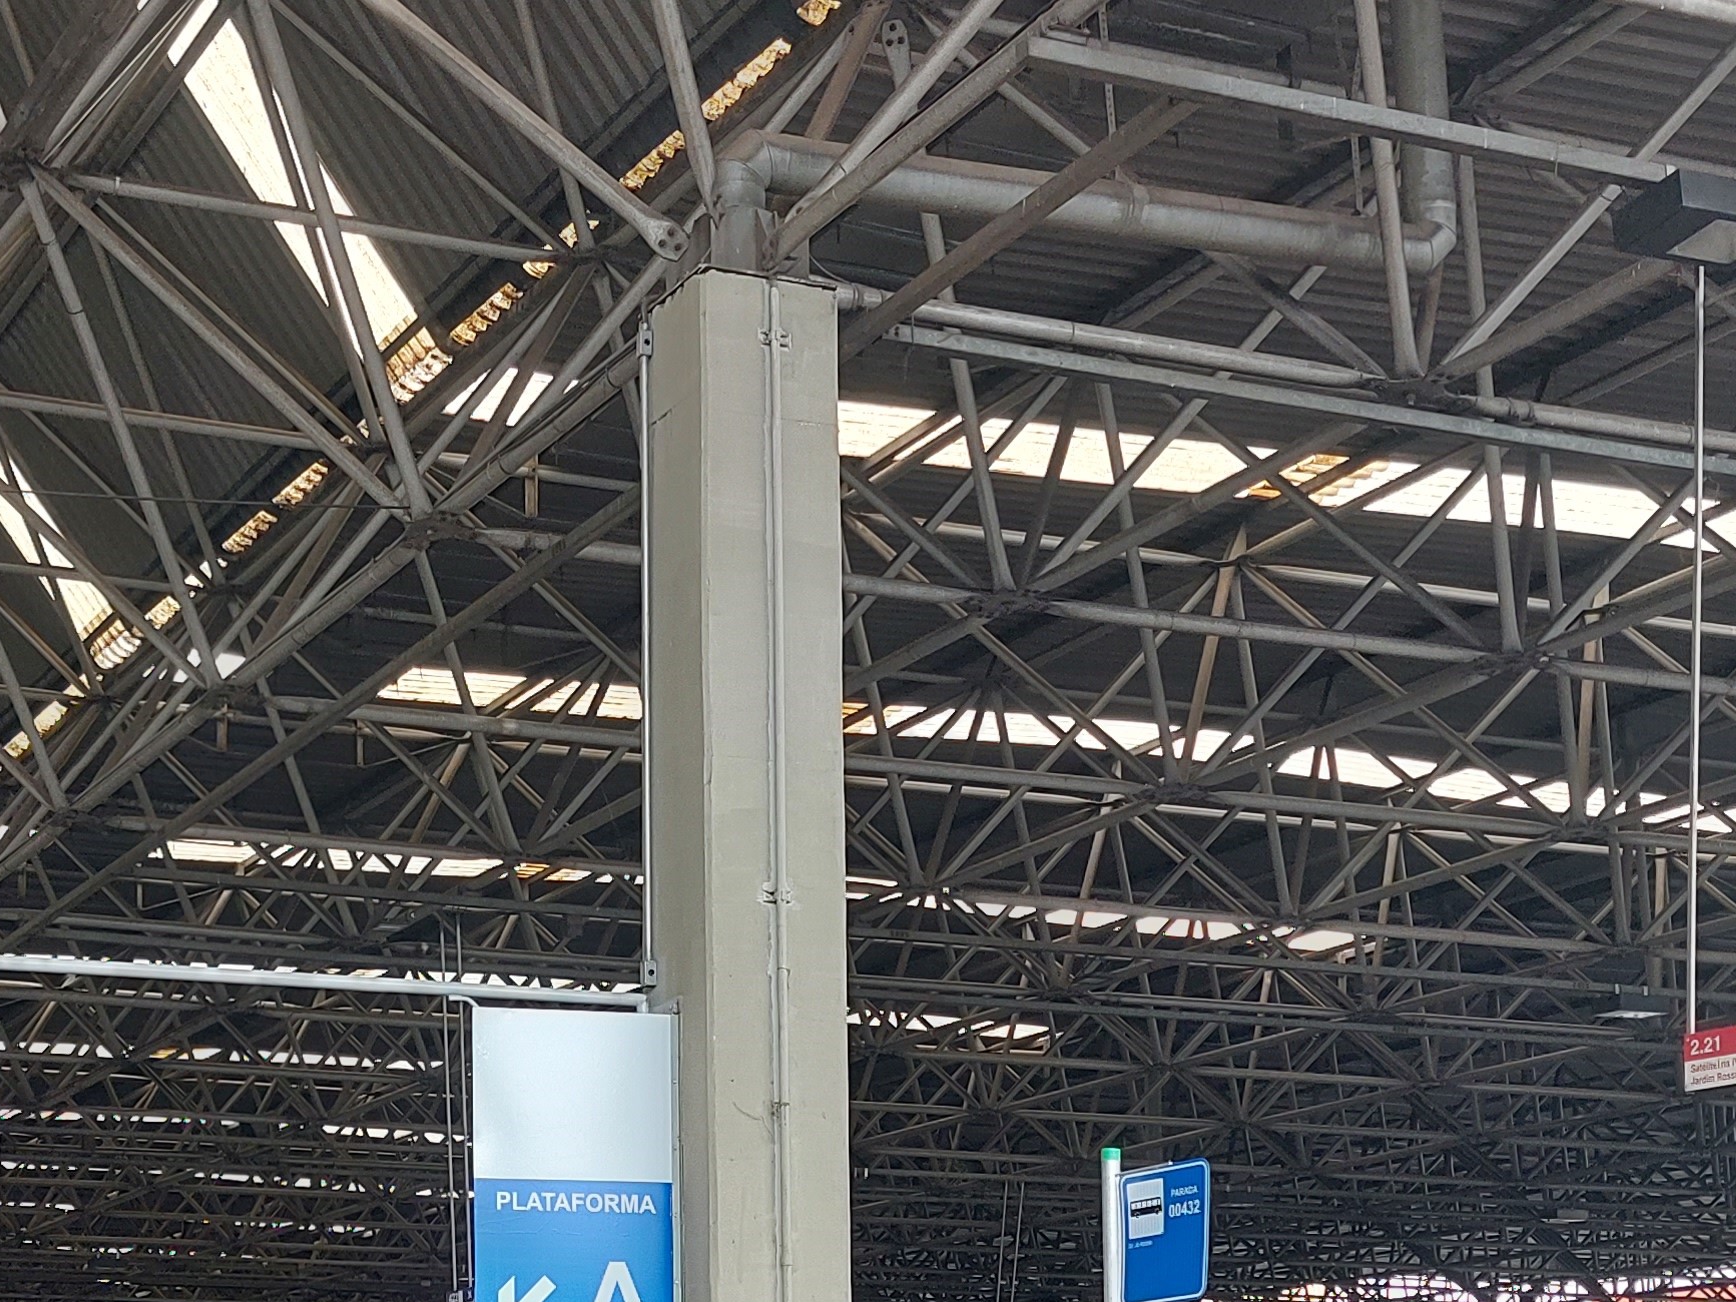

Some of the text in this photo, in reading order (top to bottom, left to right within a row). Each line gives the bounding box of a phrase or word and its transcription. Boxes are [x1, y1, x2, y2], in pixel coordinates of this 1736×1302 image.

[1690, 1034, 1721, 1056] 2.21
[1170, 1185, 1200, 1198] PARADA
[496, 1191, 657, 1215] PLATAFORMA
[1168, 1199, 1202, 1218] 00432
